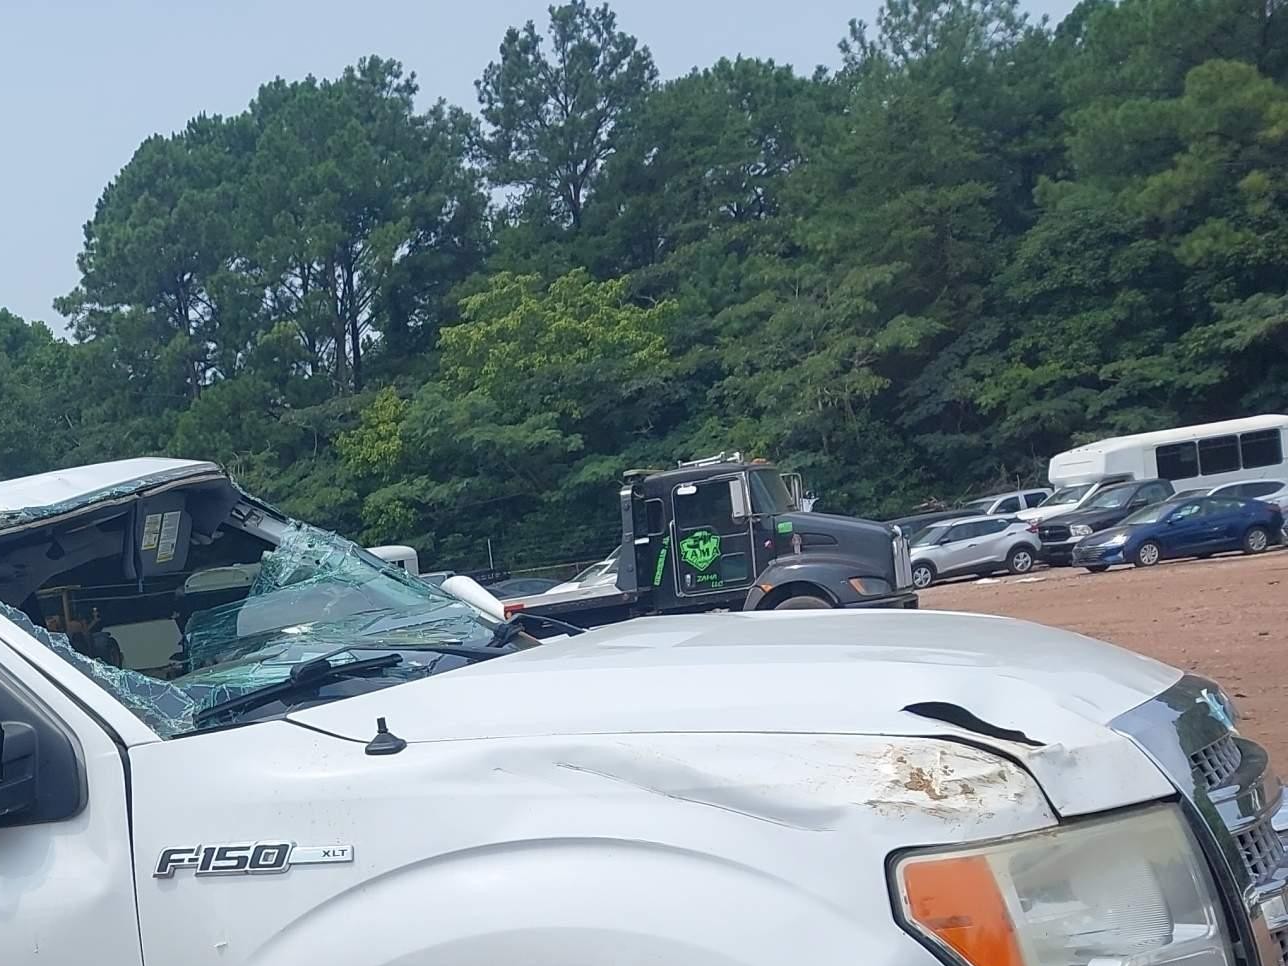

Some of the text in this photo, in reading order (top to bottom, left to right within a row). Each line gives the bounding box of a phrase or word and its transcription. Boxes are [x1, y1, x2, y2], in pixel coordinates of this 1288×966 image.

[683, 546, 719, 561] ZAMA
[152, 844, 348, 878] F-150 XLT
